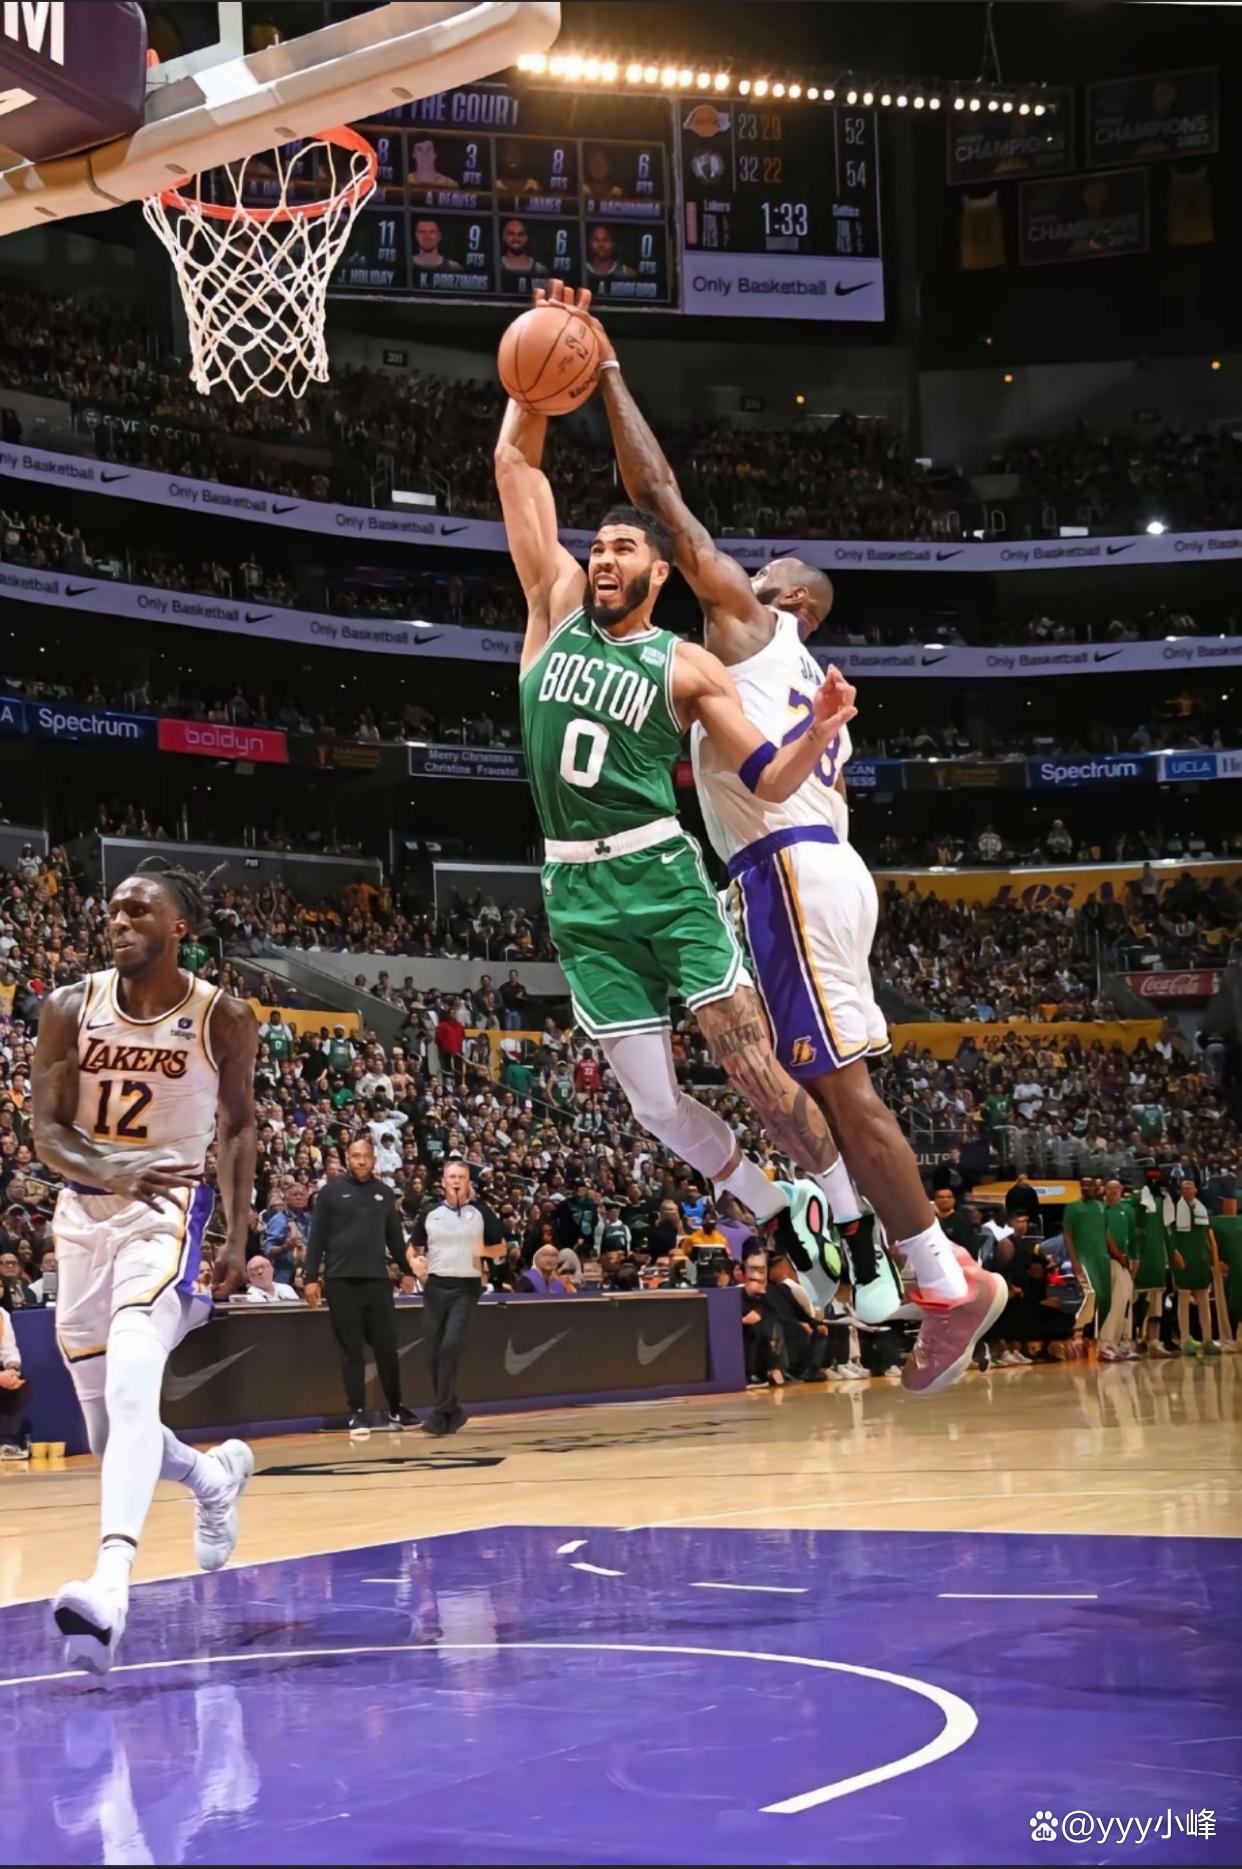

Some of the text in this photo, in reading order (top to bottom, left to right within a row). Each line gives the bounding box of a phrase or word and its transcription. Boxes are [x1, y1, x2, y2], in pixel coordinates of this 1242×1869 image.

[452, 92, 519, 126] COURT
[738, 113, 758, 140] 23
[761, 114, 782, 141] 29
[845, 118, 865, 144] 52
[378, 138, 389, 164] 8
[466, 143, 478, 168] 3
[552, 149, 564, 174] 8
[639, 154, 650, 179] 6
[739, 155, 783, 183] 32 22
[847, 161, 867, 188] 54
[761, 202, 809, 236] 1:33
[378, 219, 396, 247] 11
[468, 224, 481, 250] 9
[555, 229, 568, 255] 6
[378, 248, 396, 262] PTS
[641, 233, 653, 259] 0
[466, 252, 485, 267] PTS
[553, 256, 571, 271] PTS
[693, 275, 827, 297] Only Basketball
[0, 453, 94, 480] nly Basketball
[168, 482, 267, 513] Only Basketball
[335, 513, 436, 536] Only Basketball
[835, 548, 931, 562] Only Basketball
[1000, 546, 1101, 563] Only Basketball
[1174, 539, 1203, 553] Only
[136, 594, 240, 622] Only Basketball
[310, 621, 409, 645] Only Basketball
[481, 638, 510, 654] Only
[1162, 647, 1194, 661] Only
[850, 653, 916, 667] Basketball
[986, 652, 1088, 670] Only Basketball
[538, 652, 658, 734] BOSTON
[38, 707, 139, 739] Spectrum
[185, 725, 264, 756] boldyn
[560, 718, 610, 788] 0
[424, 761, 471, 775] Christine
[429, 749, 515, 764] Merry Christmas
[1172, 761, 1212, 775] UCLA
[1040, 760, 1137, 784] Spectrum
[78, 1037, 189, 1079] LAKERS
[94, 1079, 153, 1141] 12
